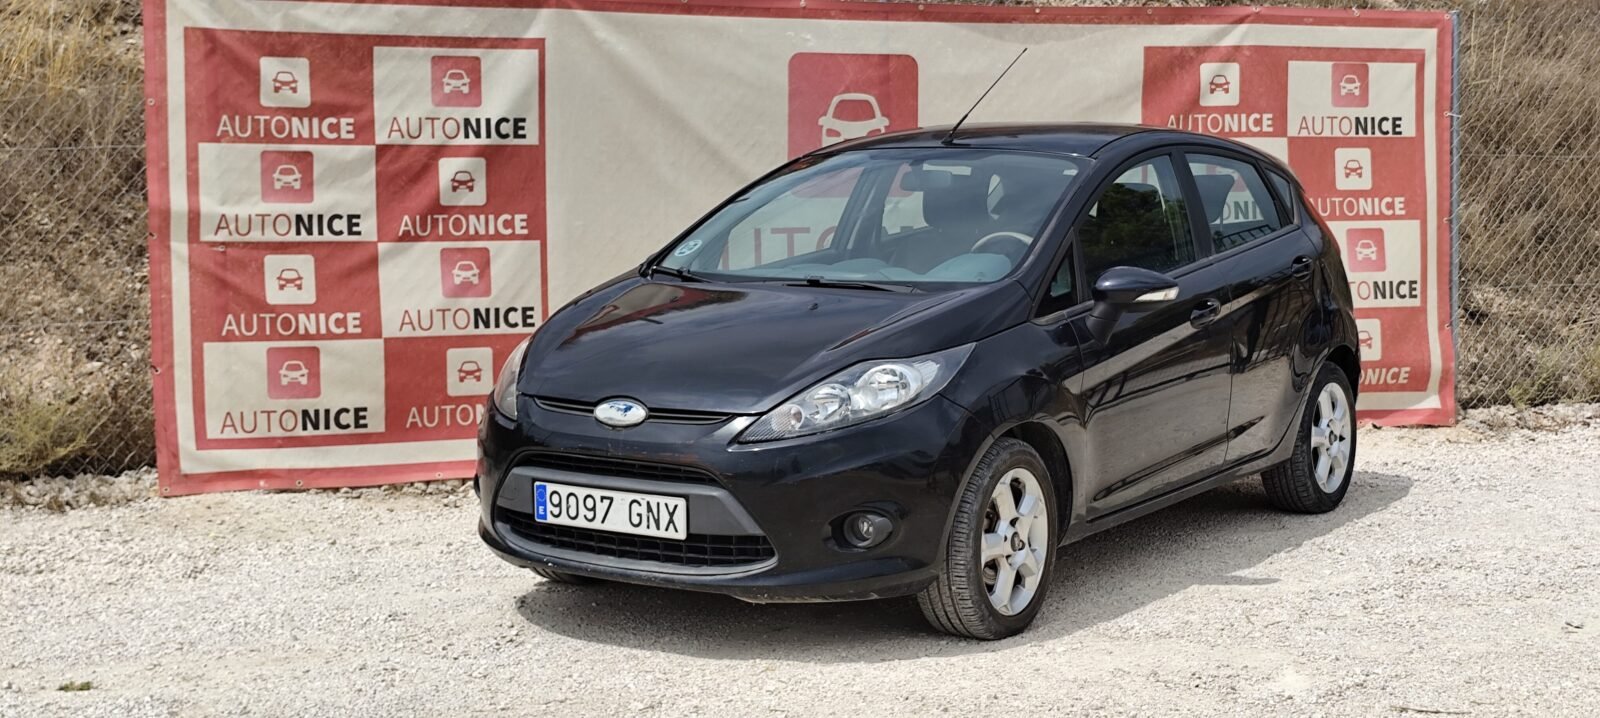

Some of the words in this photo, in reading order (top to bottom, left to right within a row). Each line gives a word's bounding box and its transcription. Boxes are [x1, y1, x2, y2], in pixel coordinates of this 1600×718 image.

[216, 114, 356, 140] AUTONICE
[387, 116, 528, 140] AUTONICE
[1166, 112, 1274, 133] AUTONICE
[1297, 115, 1403, 136] AUTONICE
[213, 213, 362, 237] AUTONICE
[398, 213, 529, 238] AUTONICE
[221, 311, 362, 337] AUTONICE
[399, 306, 536, 332] AUTONICE
[219, 406, 368, 435] AUTONICE
[538, 505, 545, 515] E
[549, 490, 614, 524] 9097
[628, 499, 679, 533] GNX
